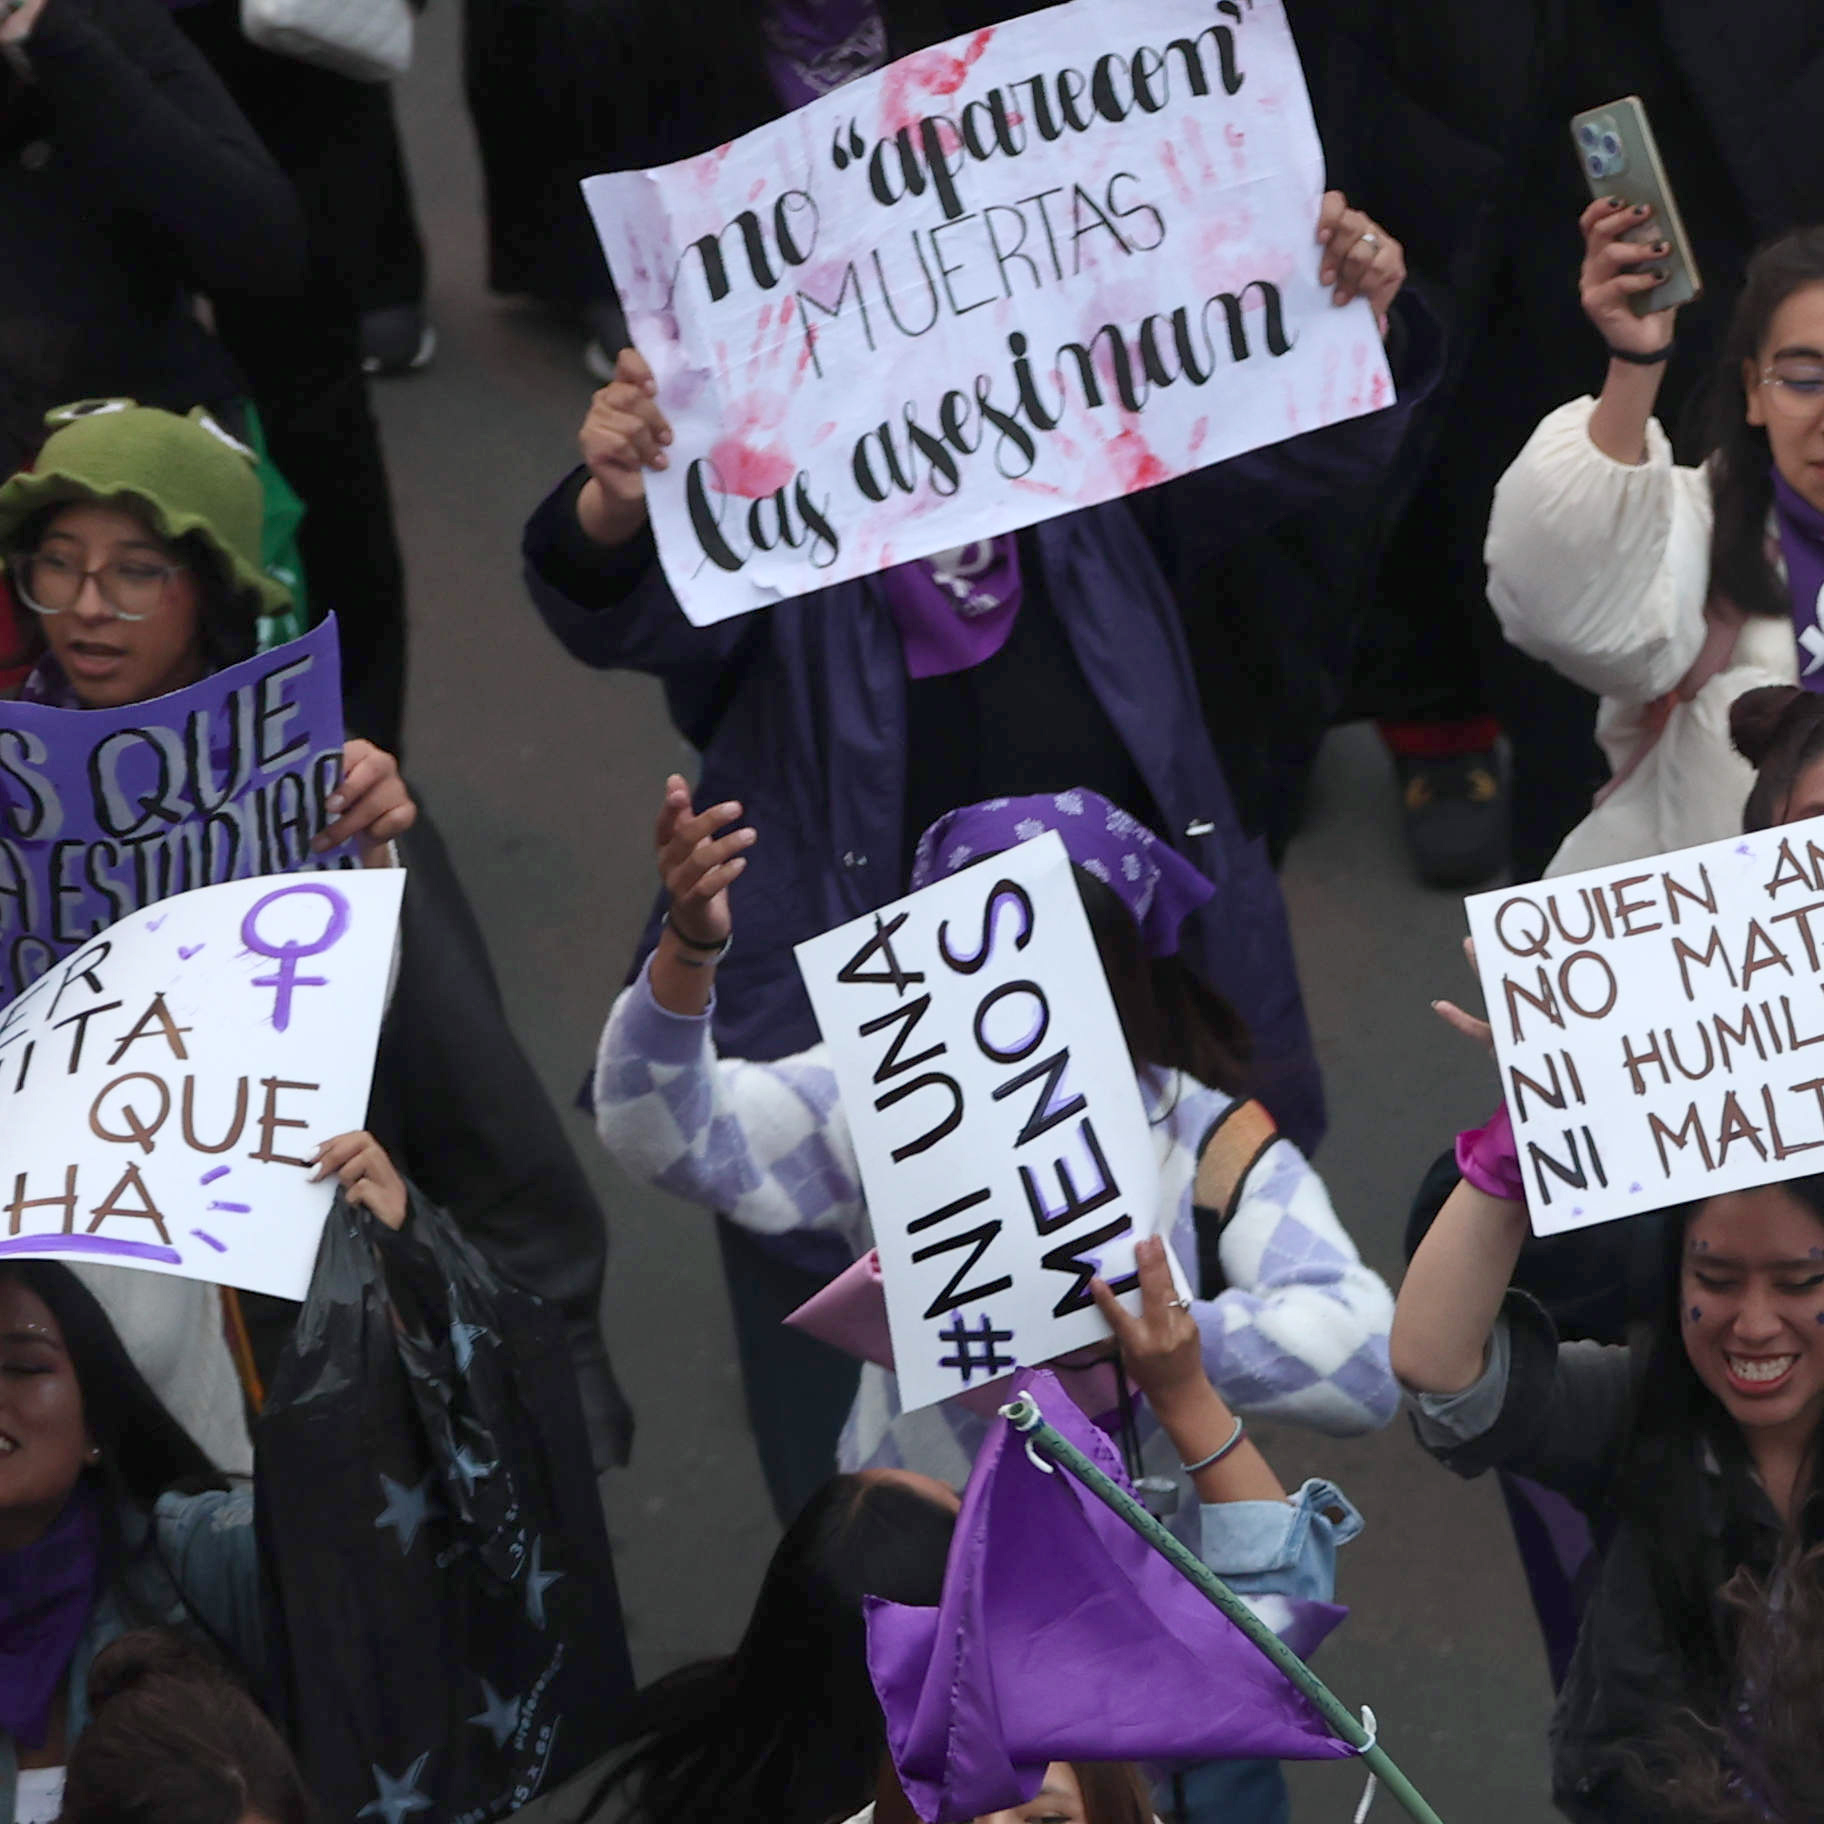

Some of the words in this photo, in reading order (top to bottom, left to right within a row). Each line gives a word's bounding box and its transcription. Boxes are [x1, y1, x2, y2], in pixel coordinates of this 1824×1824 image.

[670, 168, 821, 305] no
[796, 172, 1167, 379] MUERTAS
[684, 457, 839, 580] las
[852, 280, 1299, 504] asesinan
[87, 654, 315, 840] QUE
[1494, 862, 1719, 961] QUIEN
[836, 909, 965, 1165] UNA
[1502, 949, 1618, 1045] NO
[87, 1070, 320, 1170] QUE
[937, 877, 1141, 1320] MENOS
[1508, 1047, 1587, 1124] NI
[1527, 1124, 1609, 1207] NI
